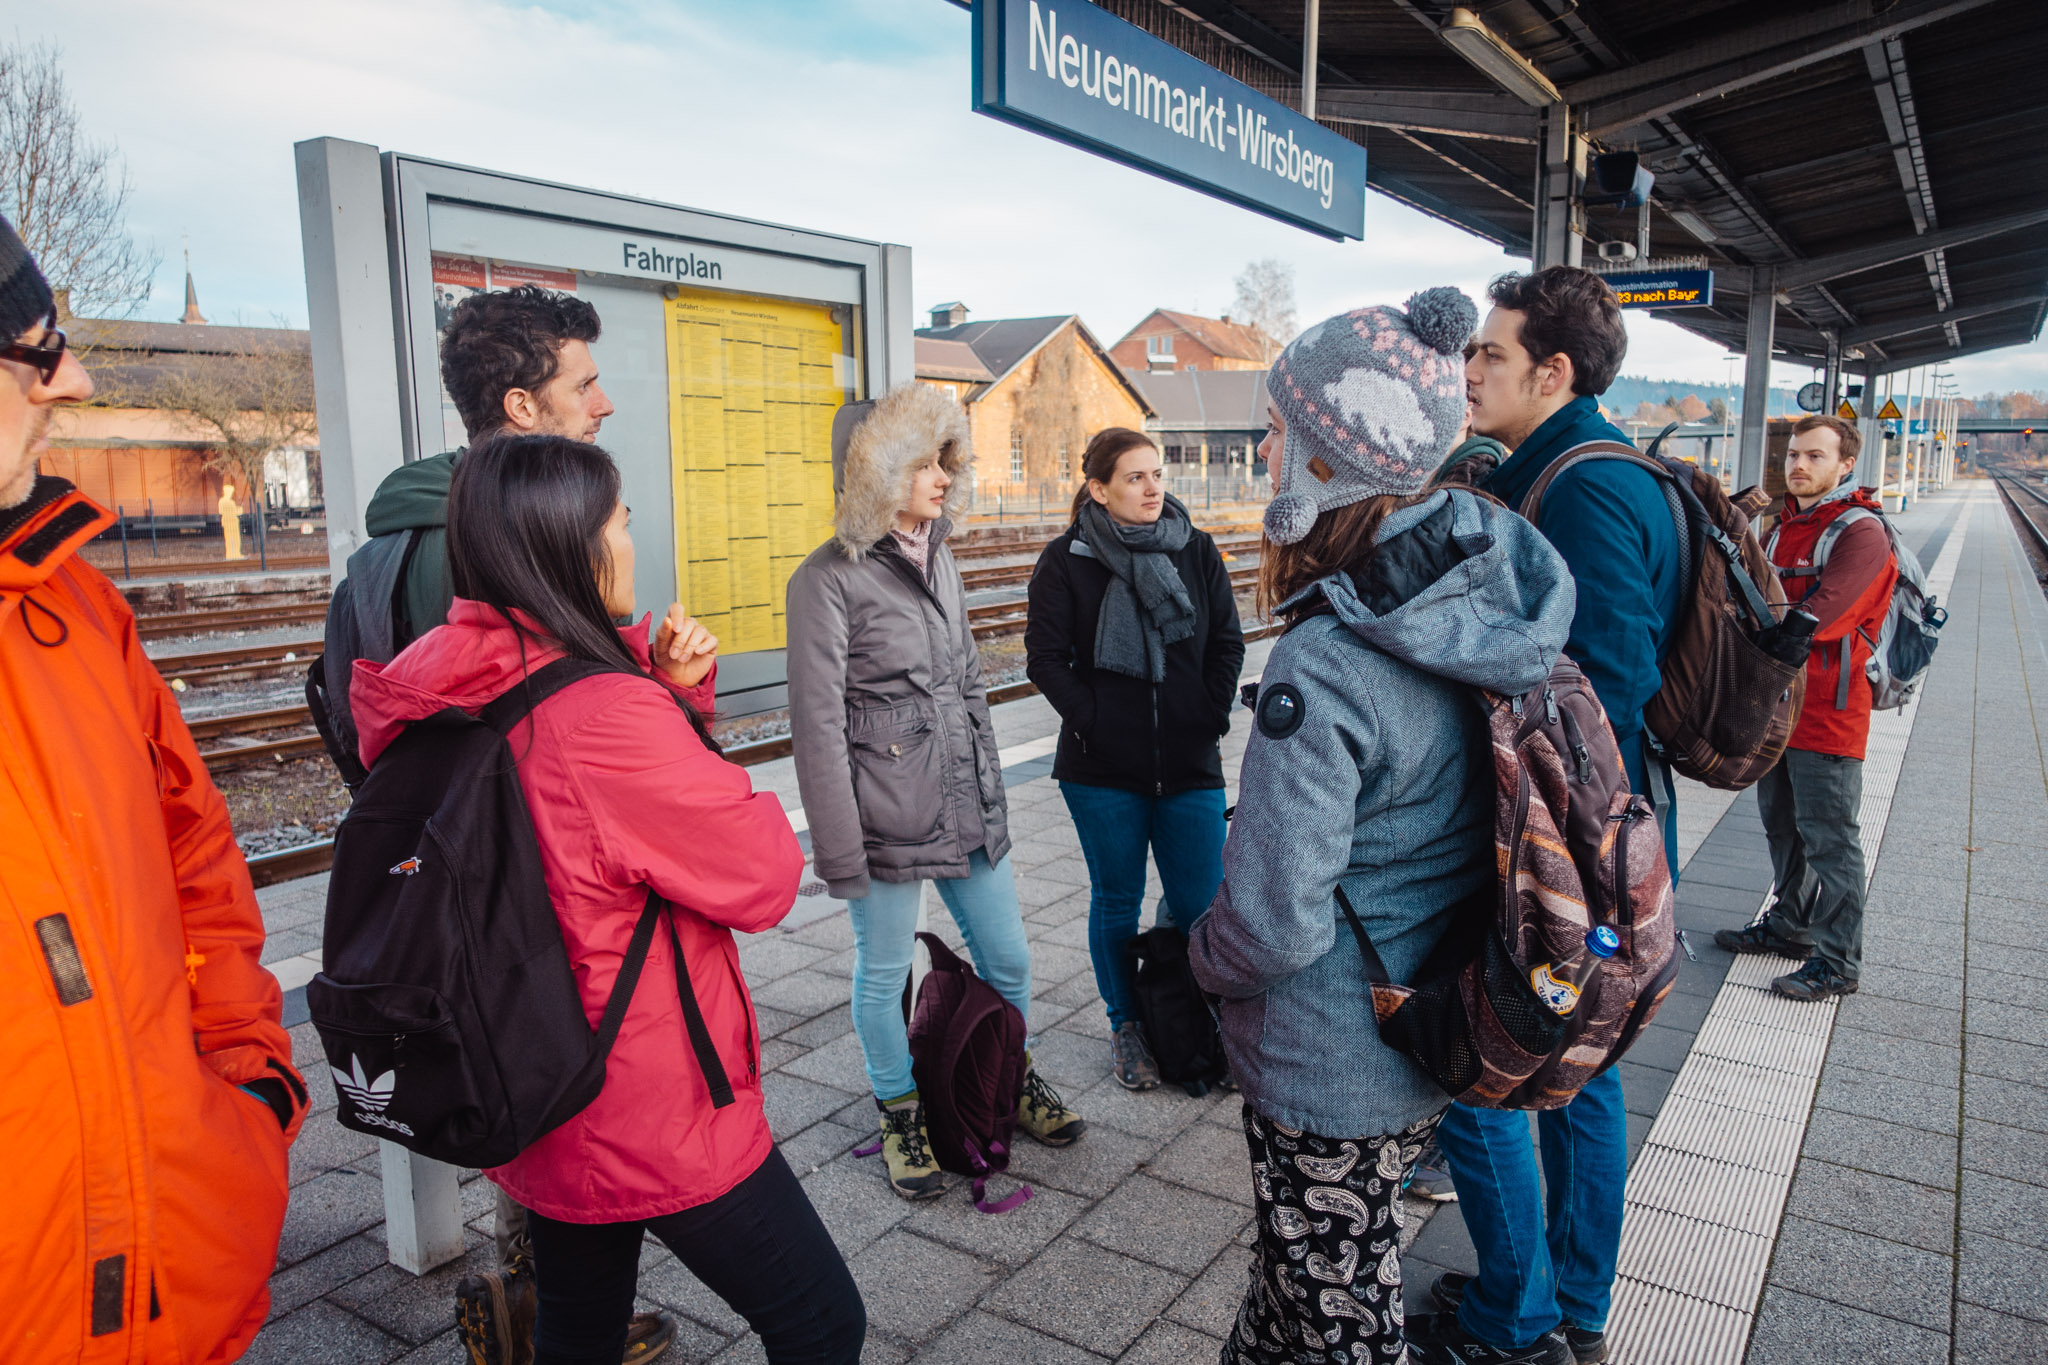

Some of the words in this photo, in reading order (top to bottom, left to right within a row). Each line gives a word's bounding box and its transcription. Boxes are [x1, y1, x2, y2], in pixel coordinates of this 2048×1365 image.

[1029, 0, 1334, 210] Neuenmarkt-Wirsberg
[623, 242, 722, 281] Fahrplan
[1633, 290, 1666, 302] nach
[1668, 289, 1699, 301] Bayr
[676, 302, 699, 311] Abfahrt
[1915, 420, 1925, 432] 4
[354, 1112, 415, 1136] adidas
